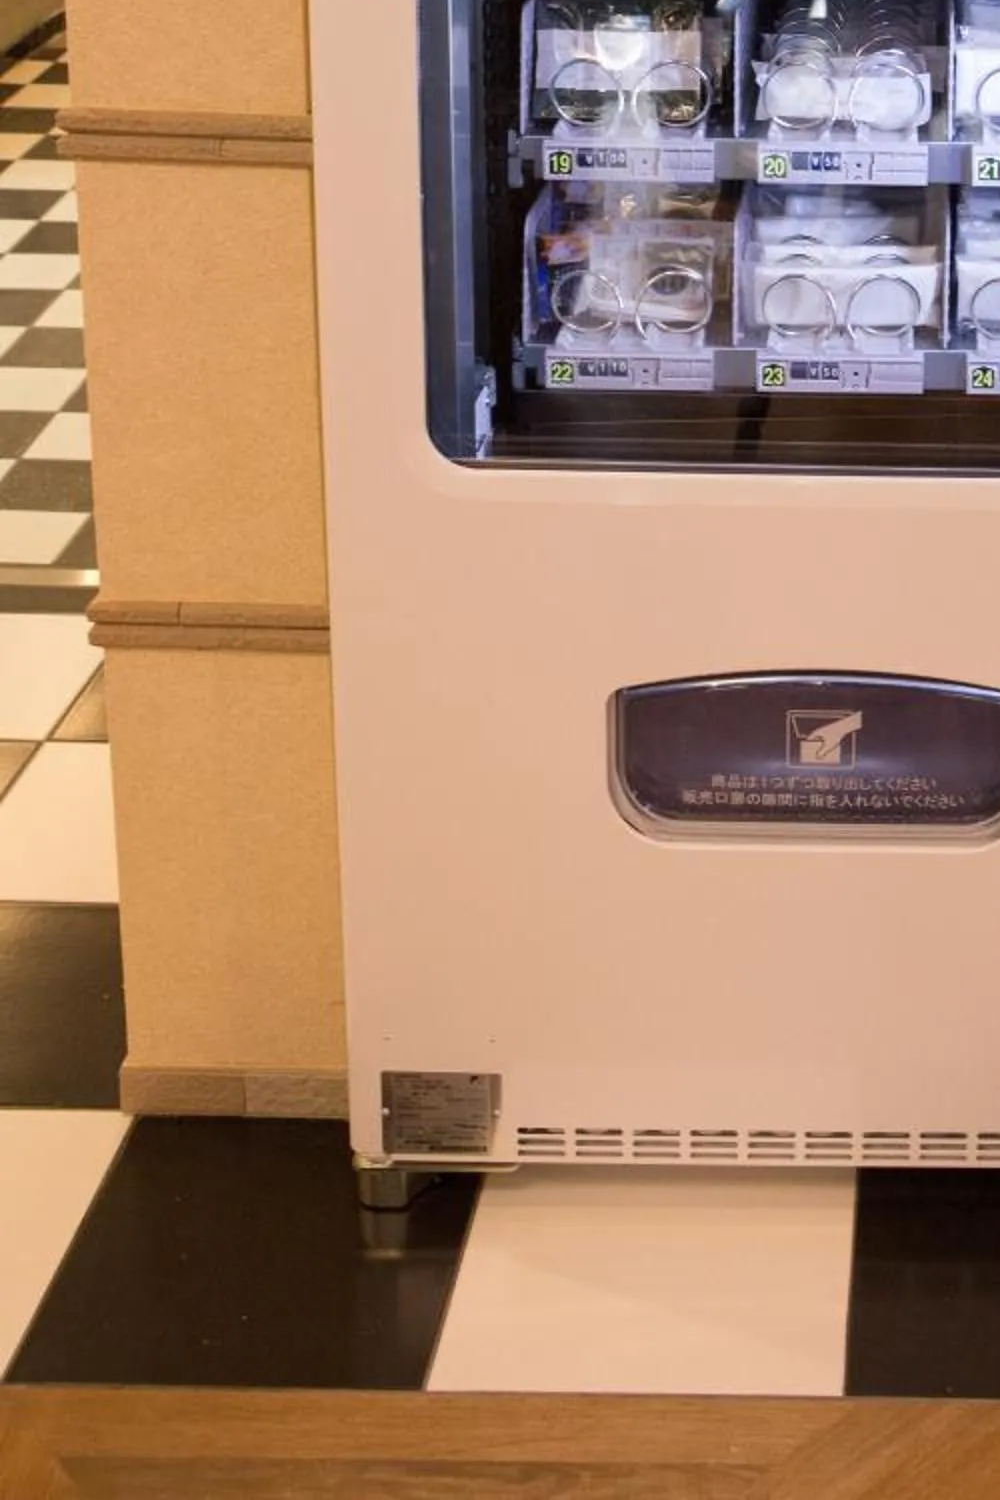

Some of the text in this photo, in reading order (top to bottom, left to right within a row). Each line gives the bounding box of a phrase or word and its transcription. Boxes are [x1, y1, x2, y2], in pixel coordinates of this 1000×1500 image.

[550, 154, 571, 174] 19
[763, 157, 786, 177] 20
[977, 159, 1000, 180] 21
[552, 363, 574, 382] 22
[763, 367, 784, 386] 23
[972, 369, 994, 388] 24
